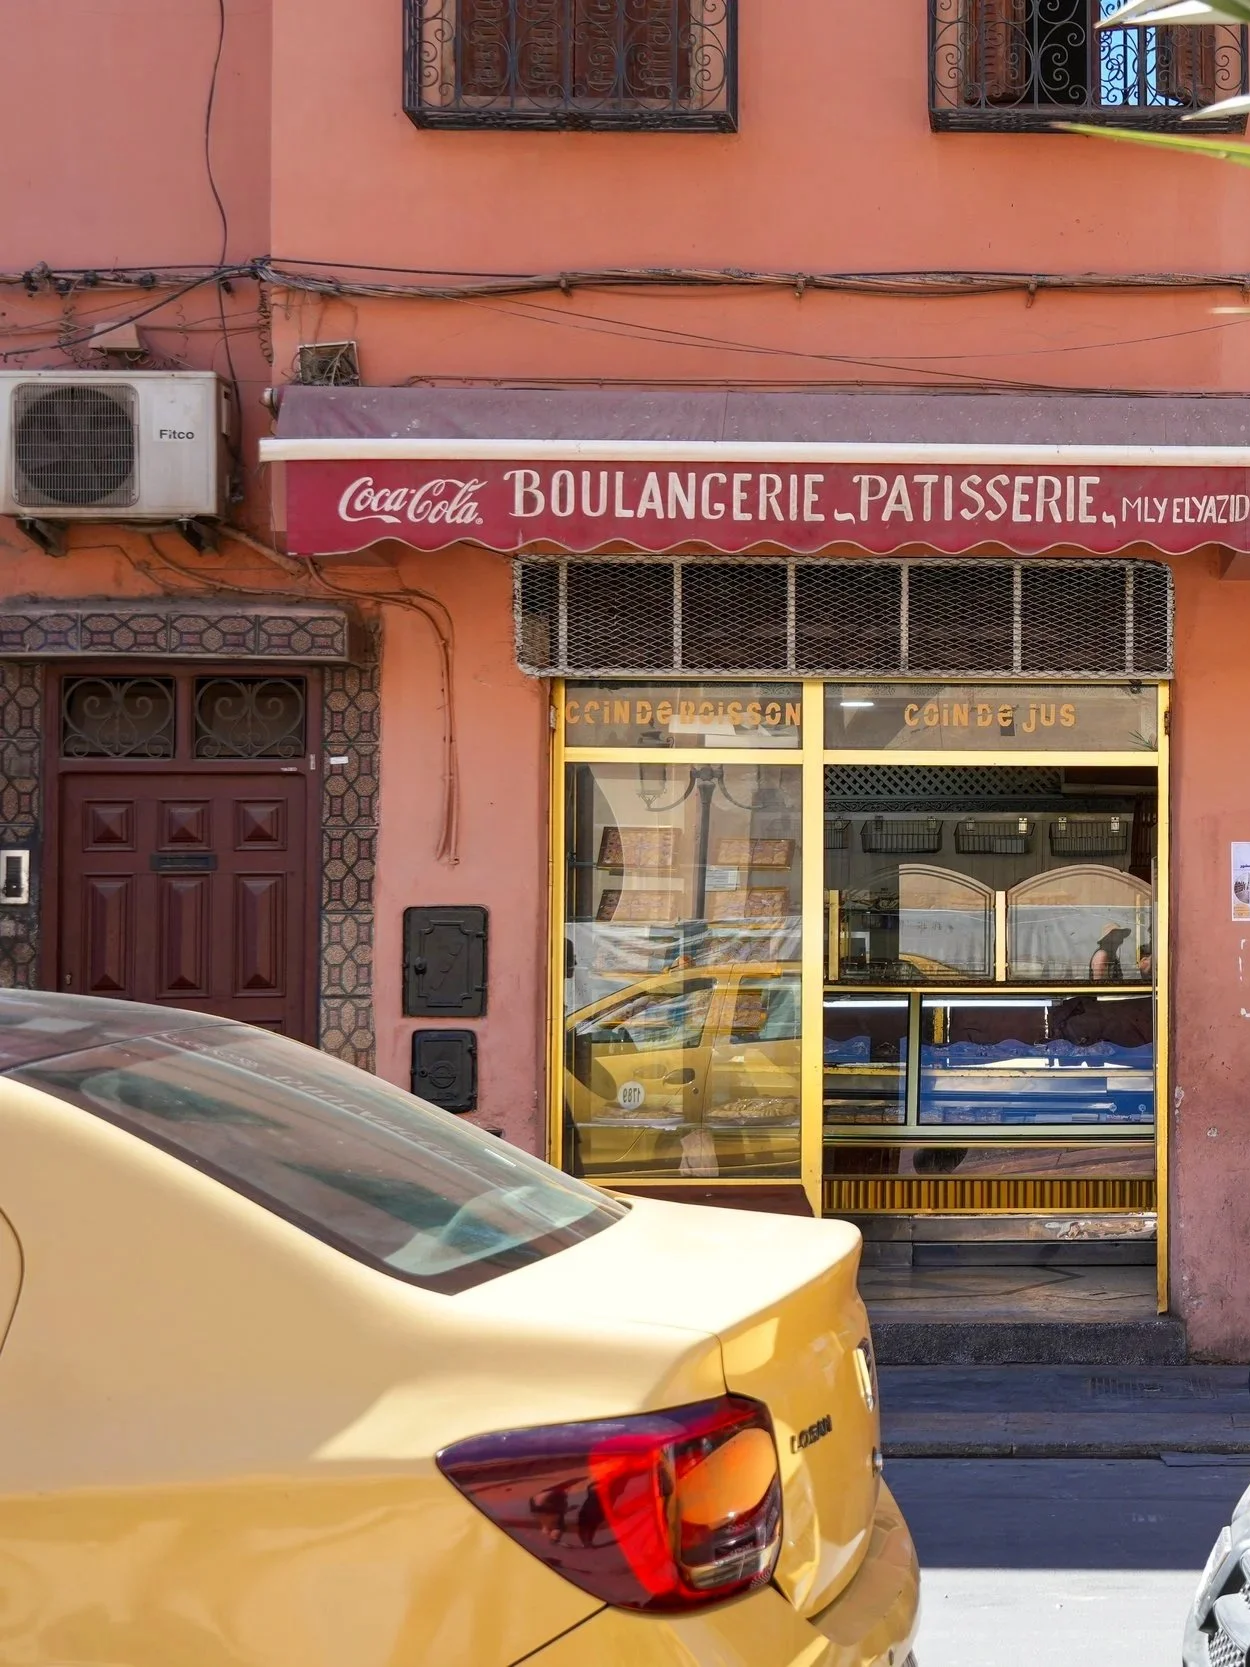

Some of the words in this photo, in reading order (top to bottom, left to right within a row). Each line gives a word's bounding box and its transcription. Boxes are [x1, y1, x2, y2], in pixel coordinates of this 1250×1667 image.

[159, 429, 194, 440] Fitco
[338, 476, 488, 525] Coca-Cola
[503, 469, 825, 521] BOULANGERIE
[852, 474, 1101, 524] PATISSERIE
[1122, 497, 1168, 523] MLY
[1172, 495, 1250, 524] ELYAZID
